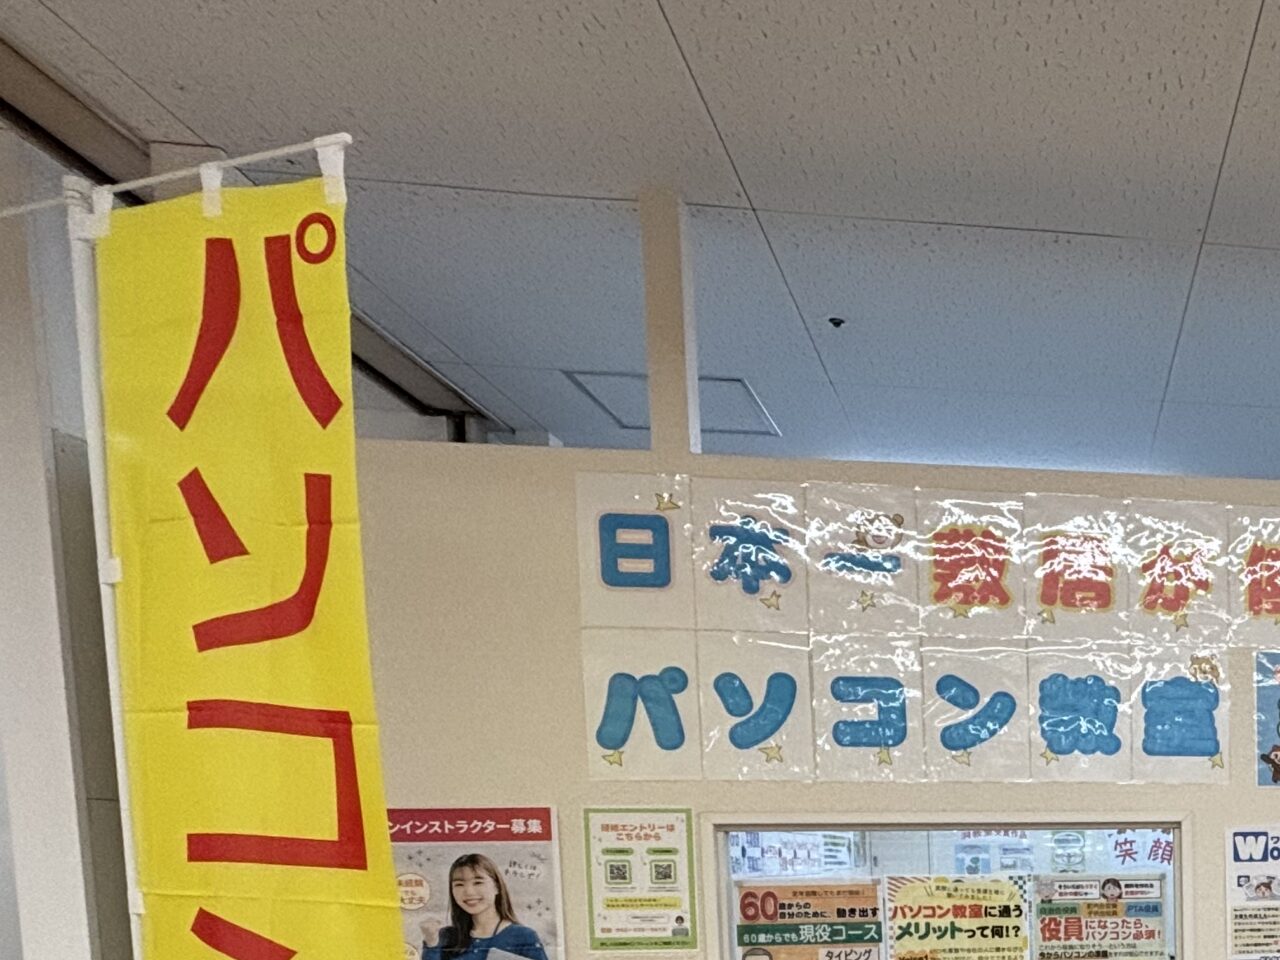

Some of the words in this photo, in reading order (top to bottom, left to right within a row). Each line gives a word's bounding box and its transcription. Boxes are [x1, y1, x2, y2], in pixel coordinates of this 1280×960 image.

[595, 665, 1223, 757] パソコン教室
[739, 890, 779, 922] 60
[891, 903, 1024, 921] パソコン教室に通う
[895, 920, 1021, 941] メリットって何!?
[1039, 916, 1085, 942] 役員
